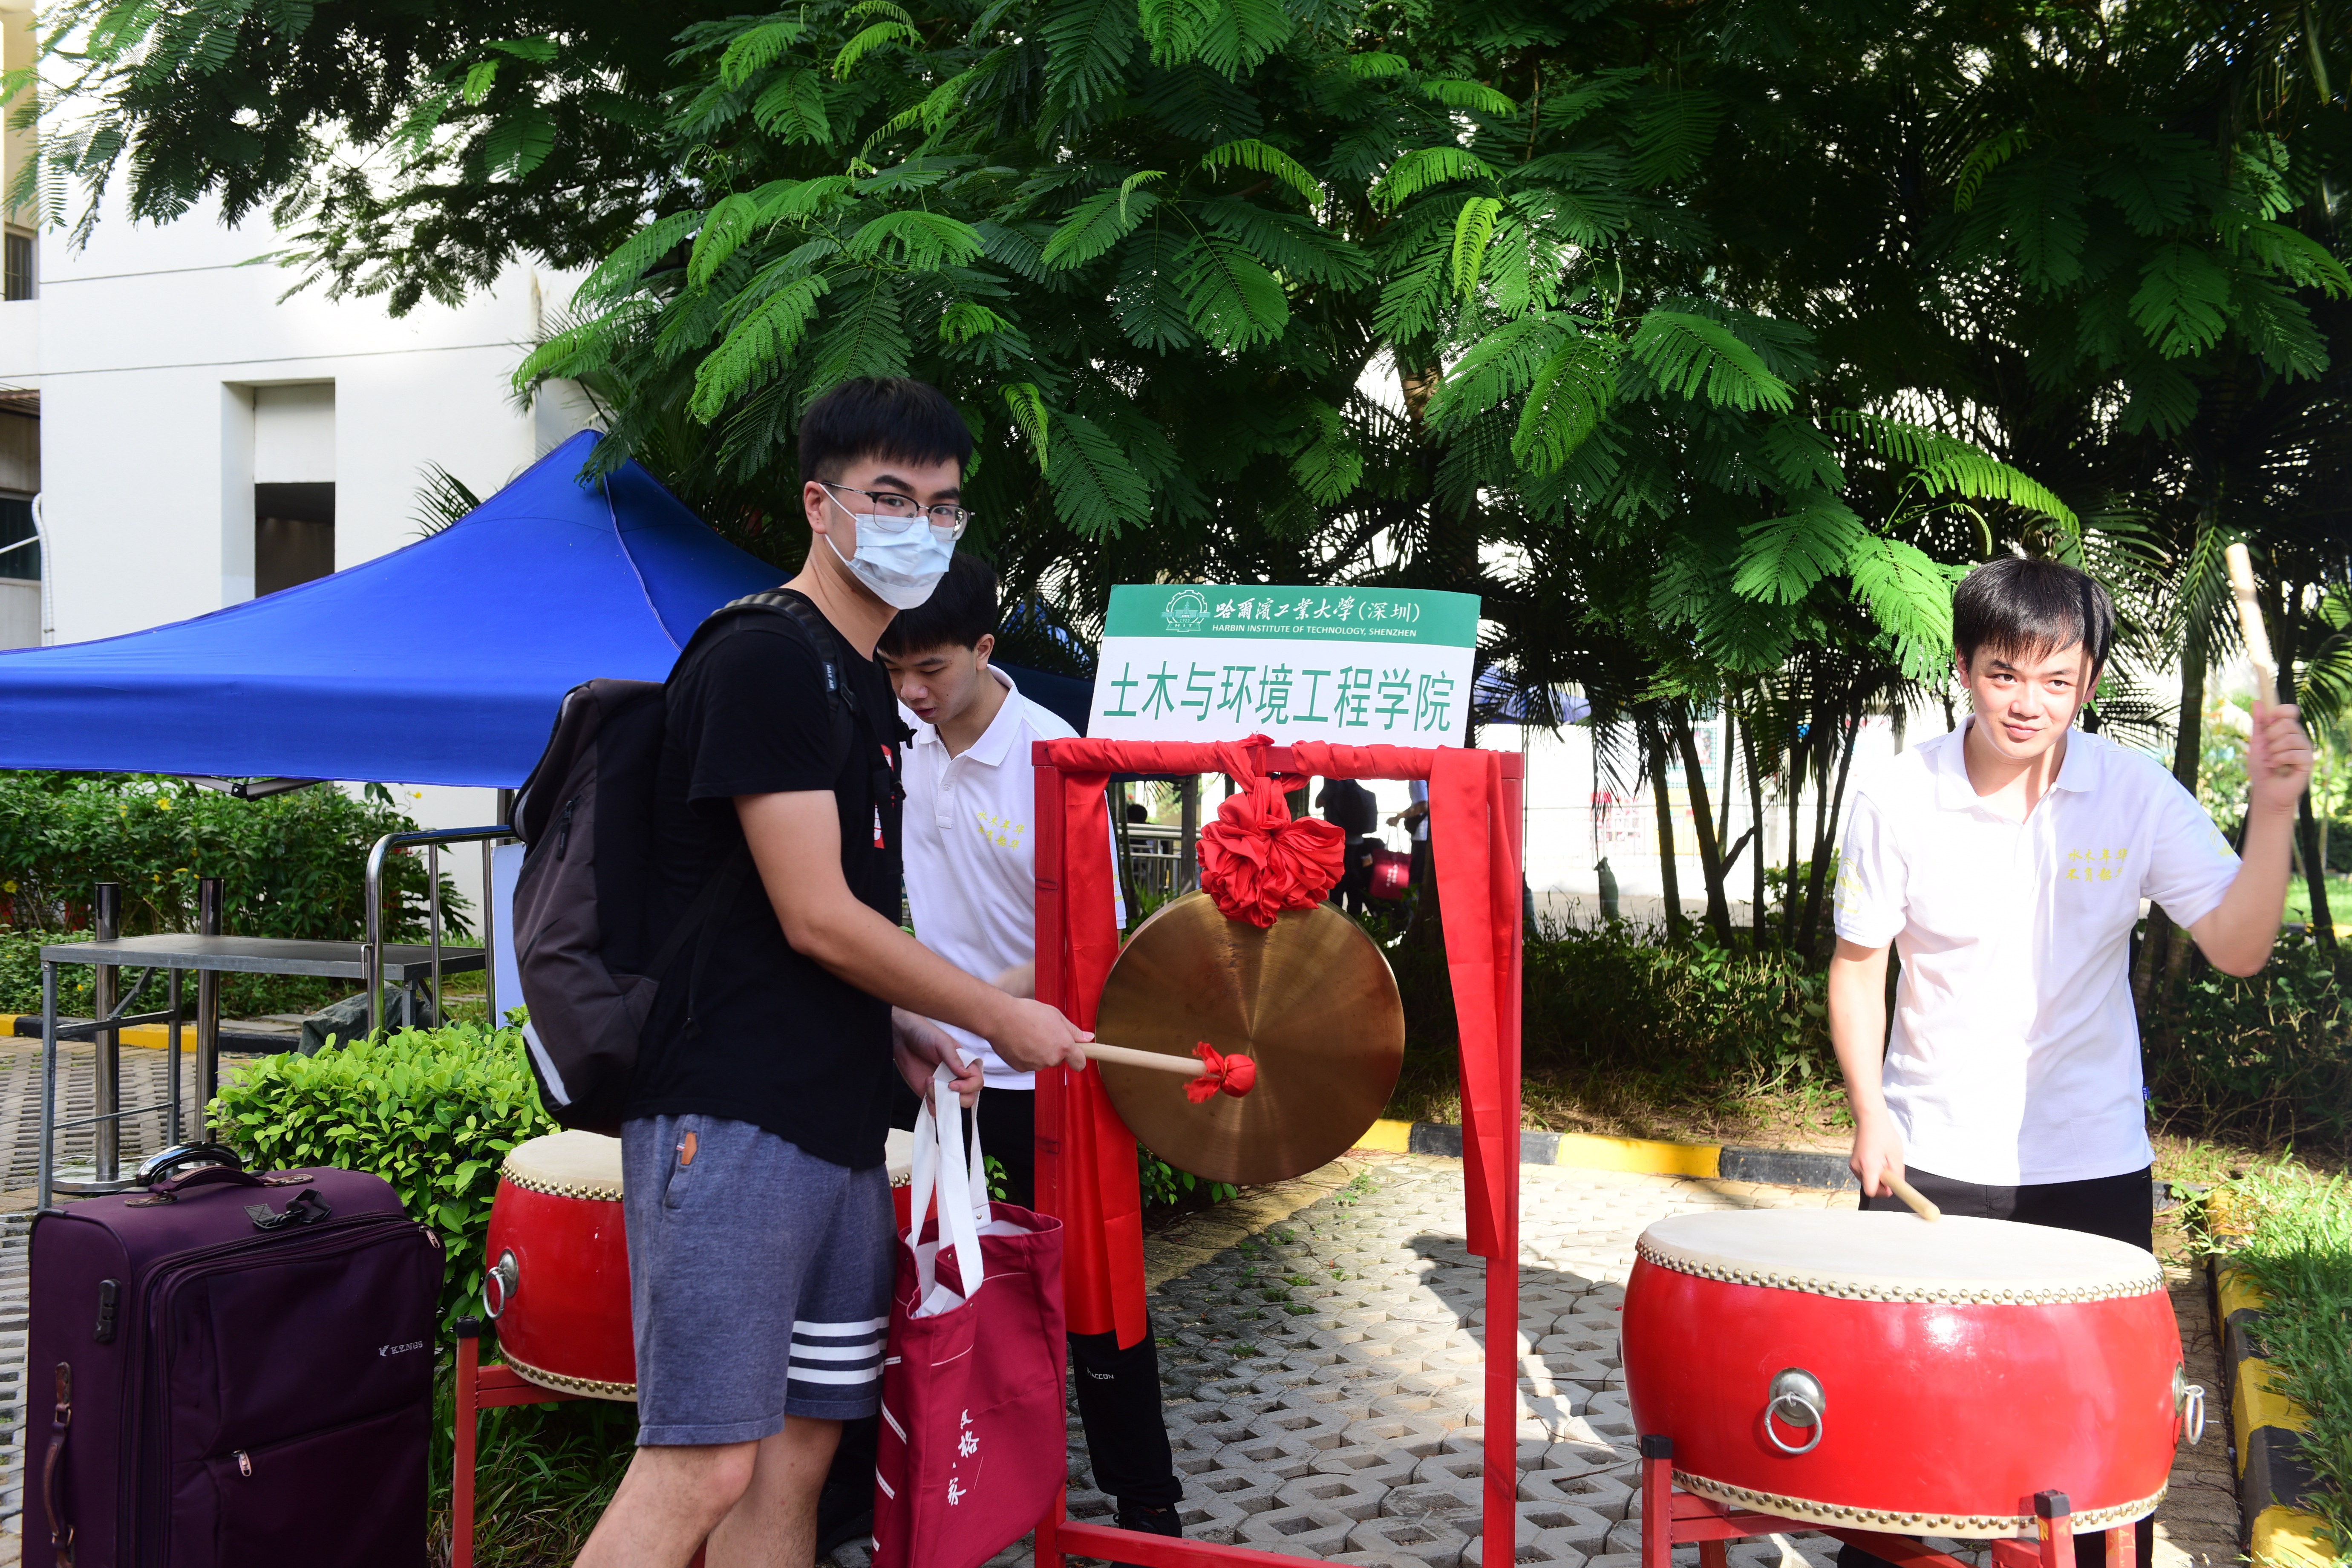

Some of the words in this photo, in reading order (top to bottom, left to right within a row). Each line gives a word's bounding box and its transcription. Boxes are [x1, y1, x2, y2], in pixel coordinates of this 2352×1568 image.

[1306, 626, 1366, 636] TECHNOLOGY,
[1369, 628, 1417, 637] SHENZHEN
[1103, 660, 1454, 732] 土木与环境工程学院
[2067, 848, 2127, 865] 水木年华
